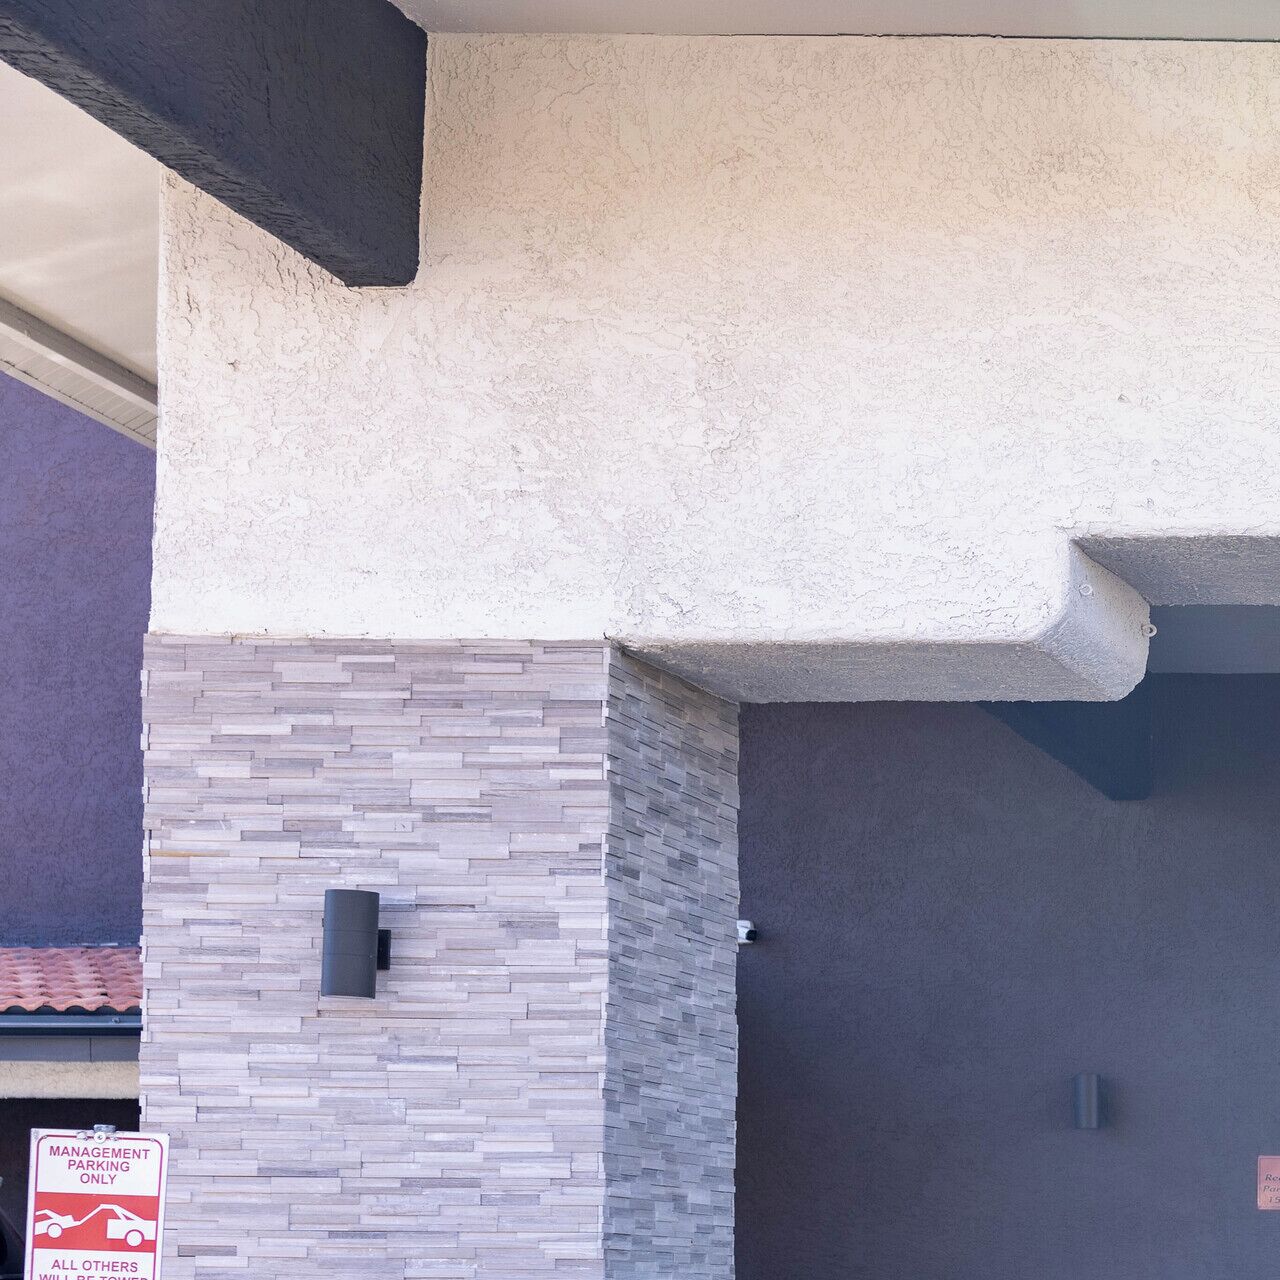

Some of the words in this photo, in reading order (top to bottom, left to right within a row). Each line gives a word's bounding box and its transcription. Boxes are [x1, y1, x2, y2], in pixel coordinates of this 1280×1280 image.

[49, 1146, 150, 1159] MANAGEMENT
[67, 1160, 130, 1172] PARKING
[80, 1173, 116, 1184] ONLY
[1268, 1196, 1280, 1204] 15
[51, 1259, 78, 1270] ALL
[82, 1260, 138, 1273] OTHERS
